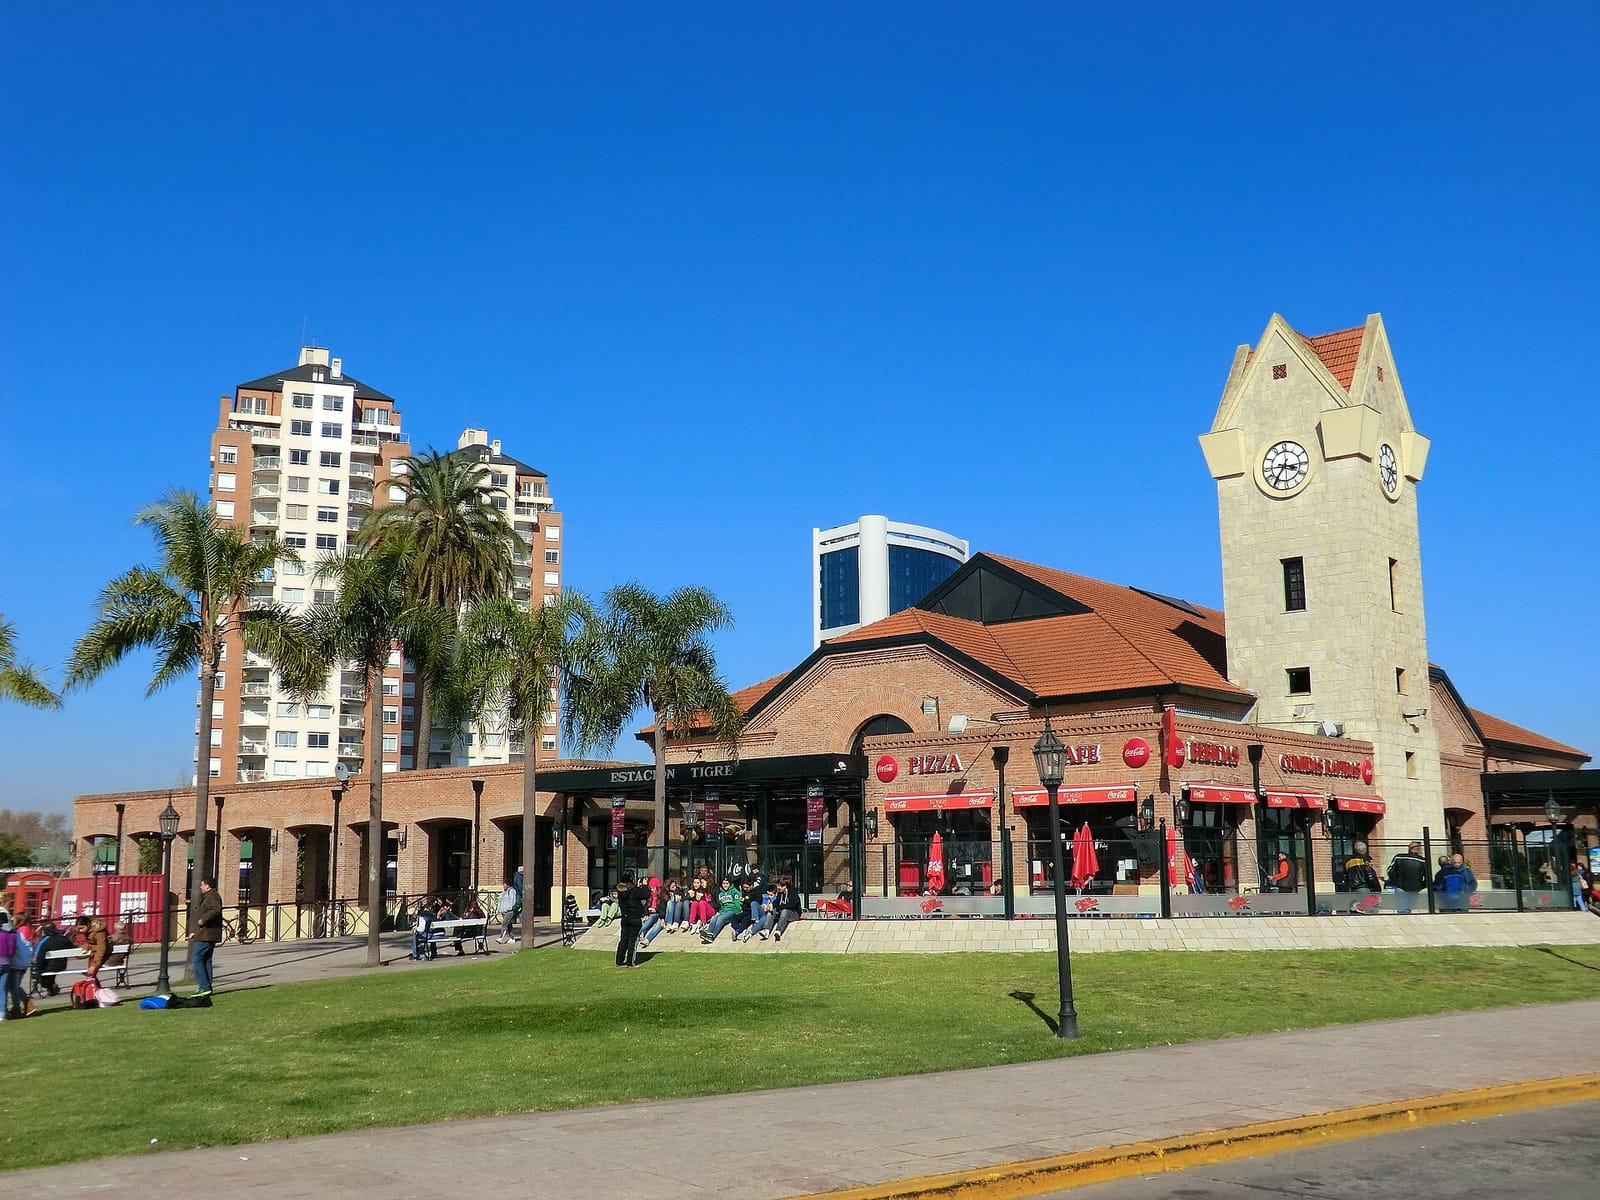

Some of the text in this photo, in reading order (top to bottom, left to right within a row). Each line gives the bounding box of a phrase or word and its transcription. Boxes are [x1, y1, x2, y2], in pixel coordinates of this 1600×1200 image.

[908, 753, 963, 775] PIZZA
[1064, 743, 1101, 765] AFE
[610, 764, 734, 783] ESTACIN TIGRE
